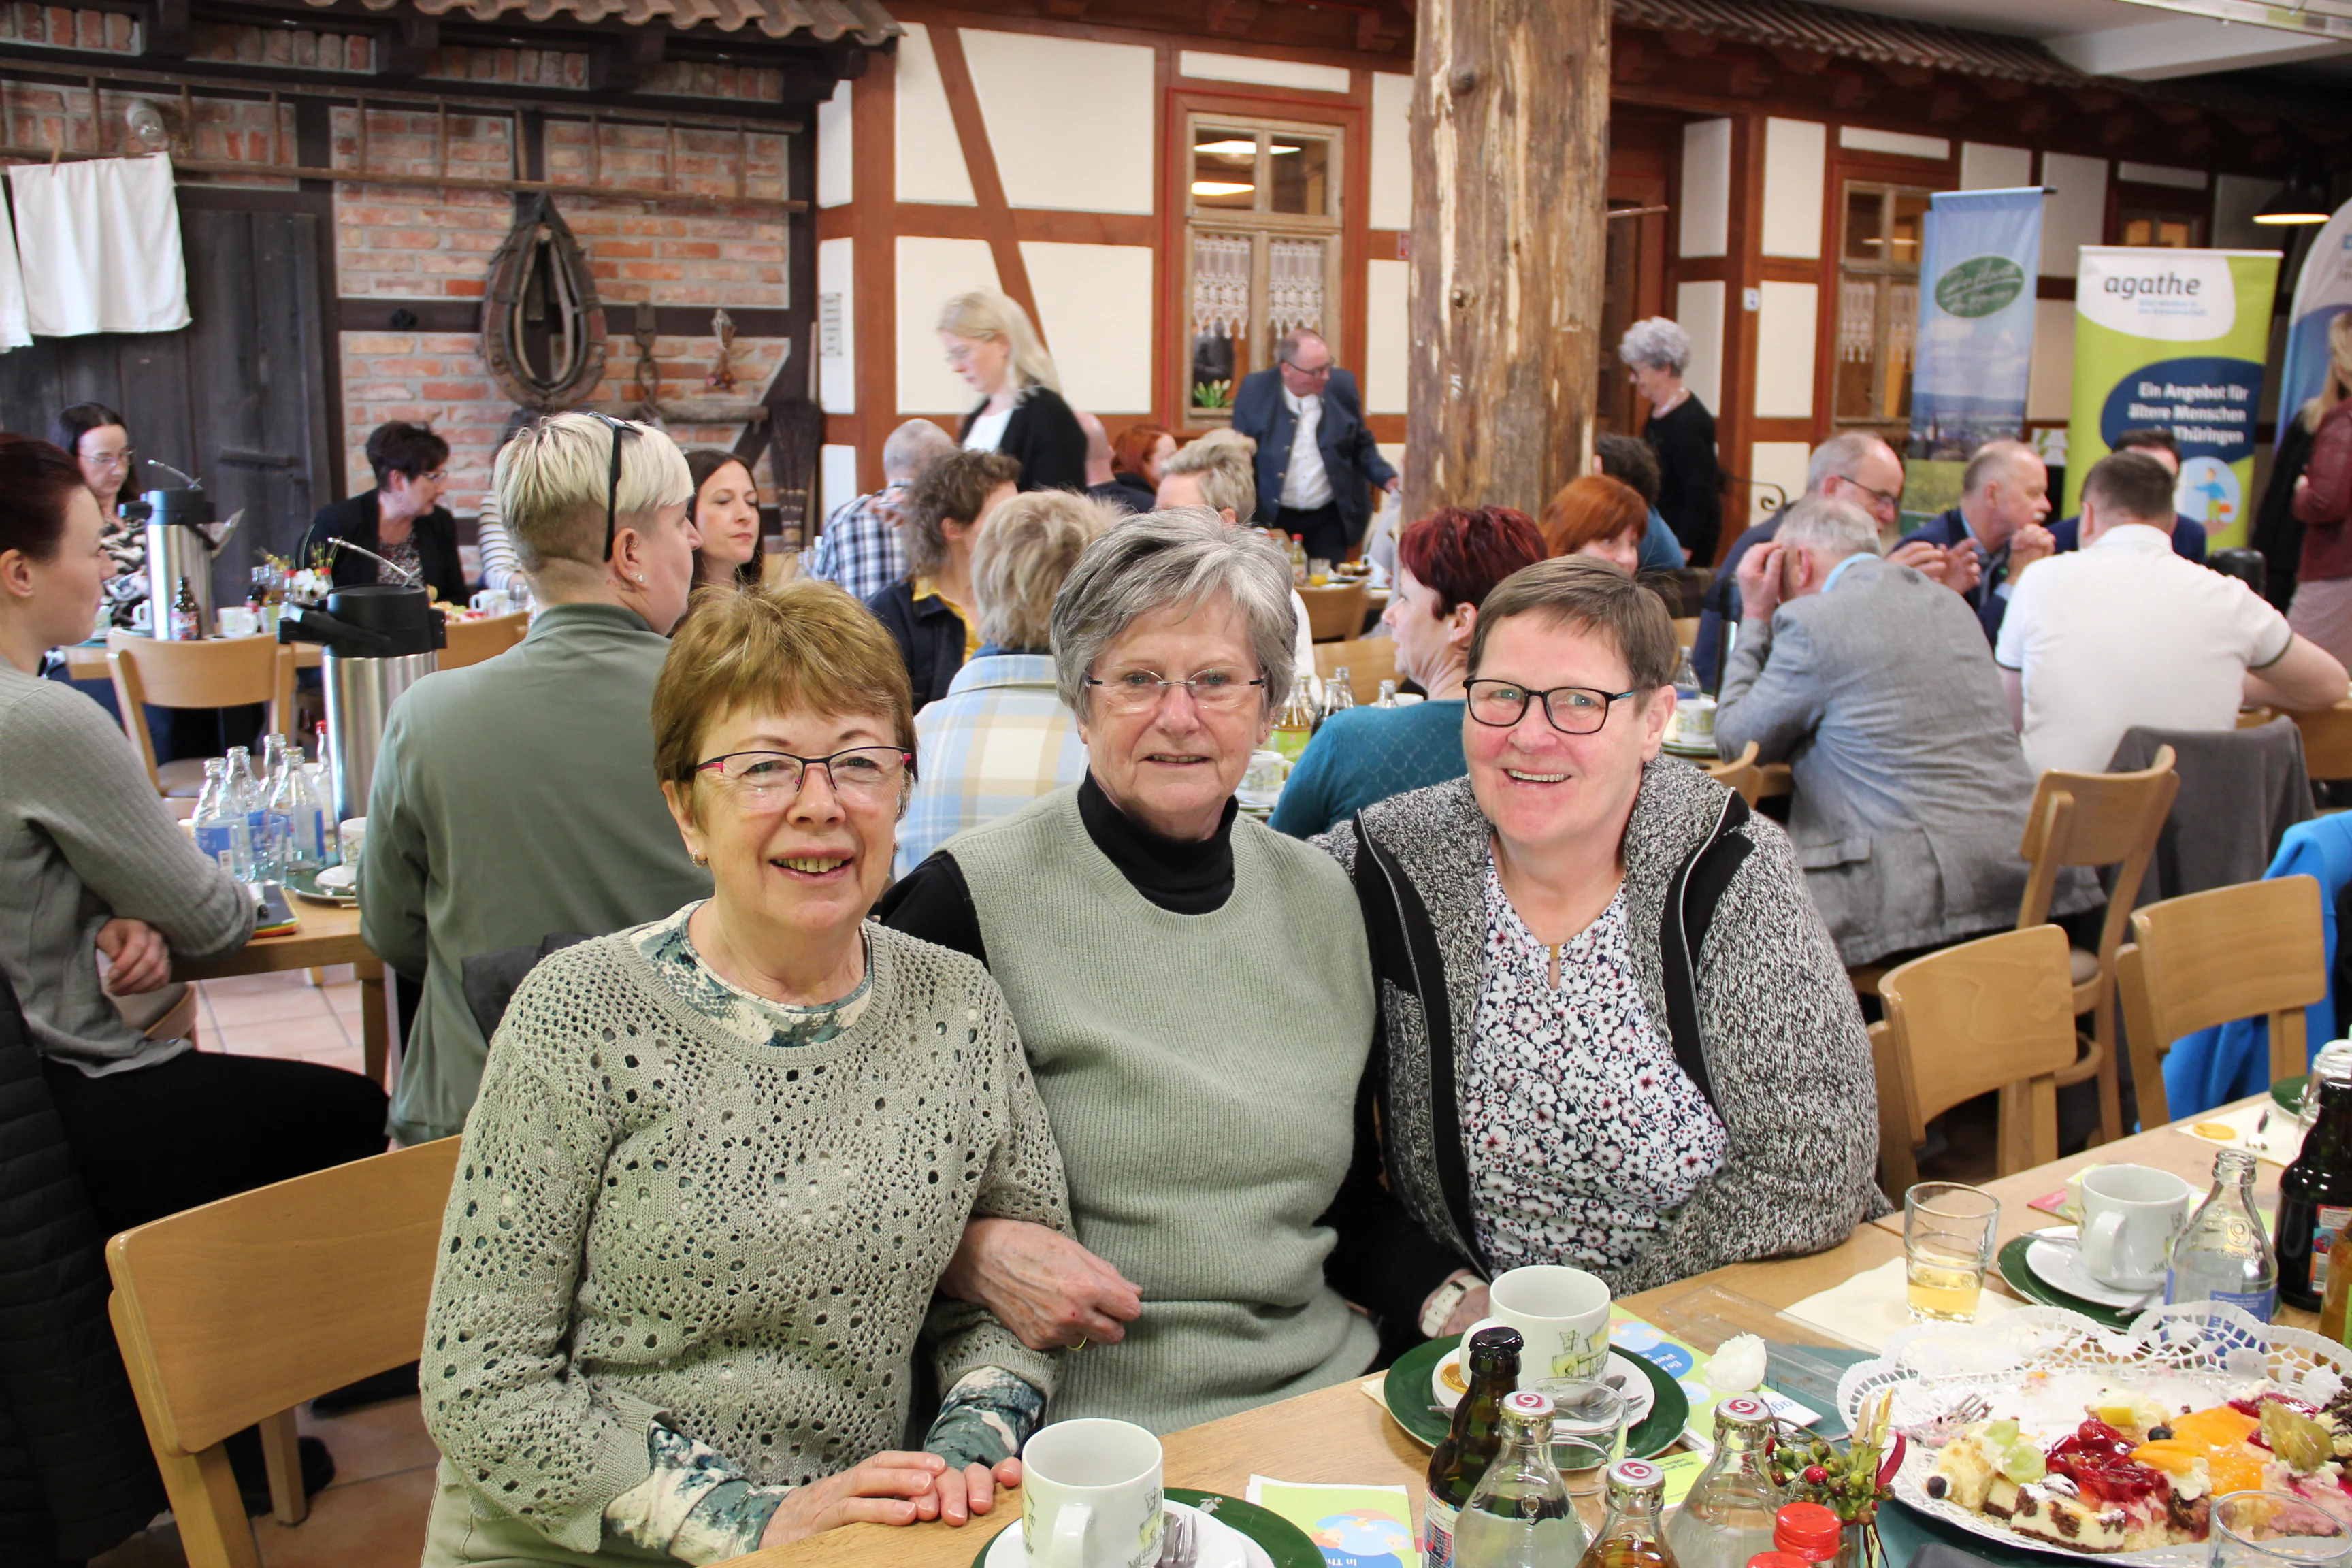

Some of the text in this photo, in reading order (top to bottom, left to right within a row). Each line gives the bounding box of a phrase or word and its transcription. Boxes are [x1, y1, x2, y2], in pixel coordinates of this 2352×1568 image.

[2104, 272, 2201, 299] agathe
[2138, 382, 2161, 399] Ein
[2163, 382, 2227, 403] Angebot
[2128, 402, 2246, 422] ältere Menschen
[2172, 425, 2244, 446] Thüringen
